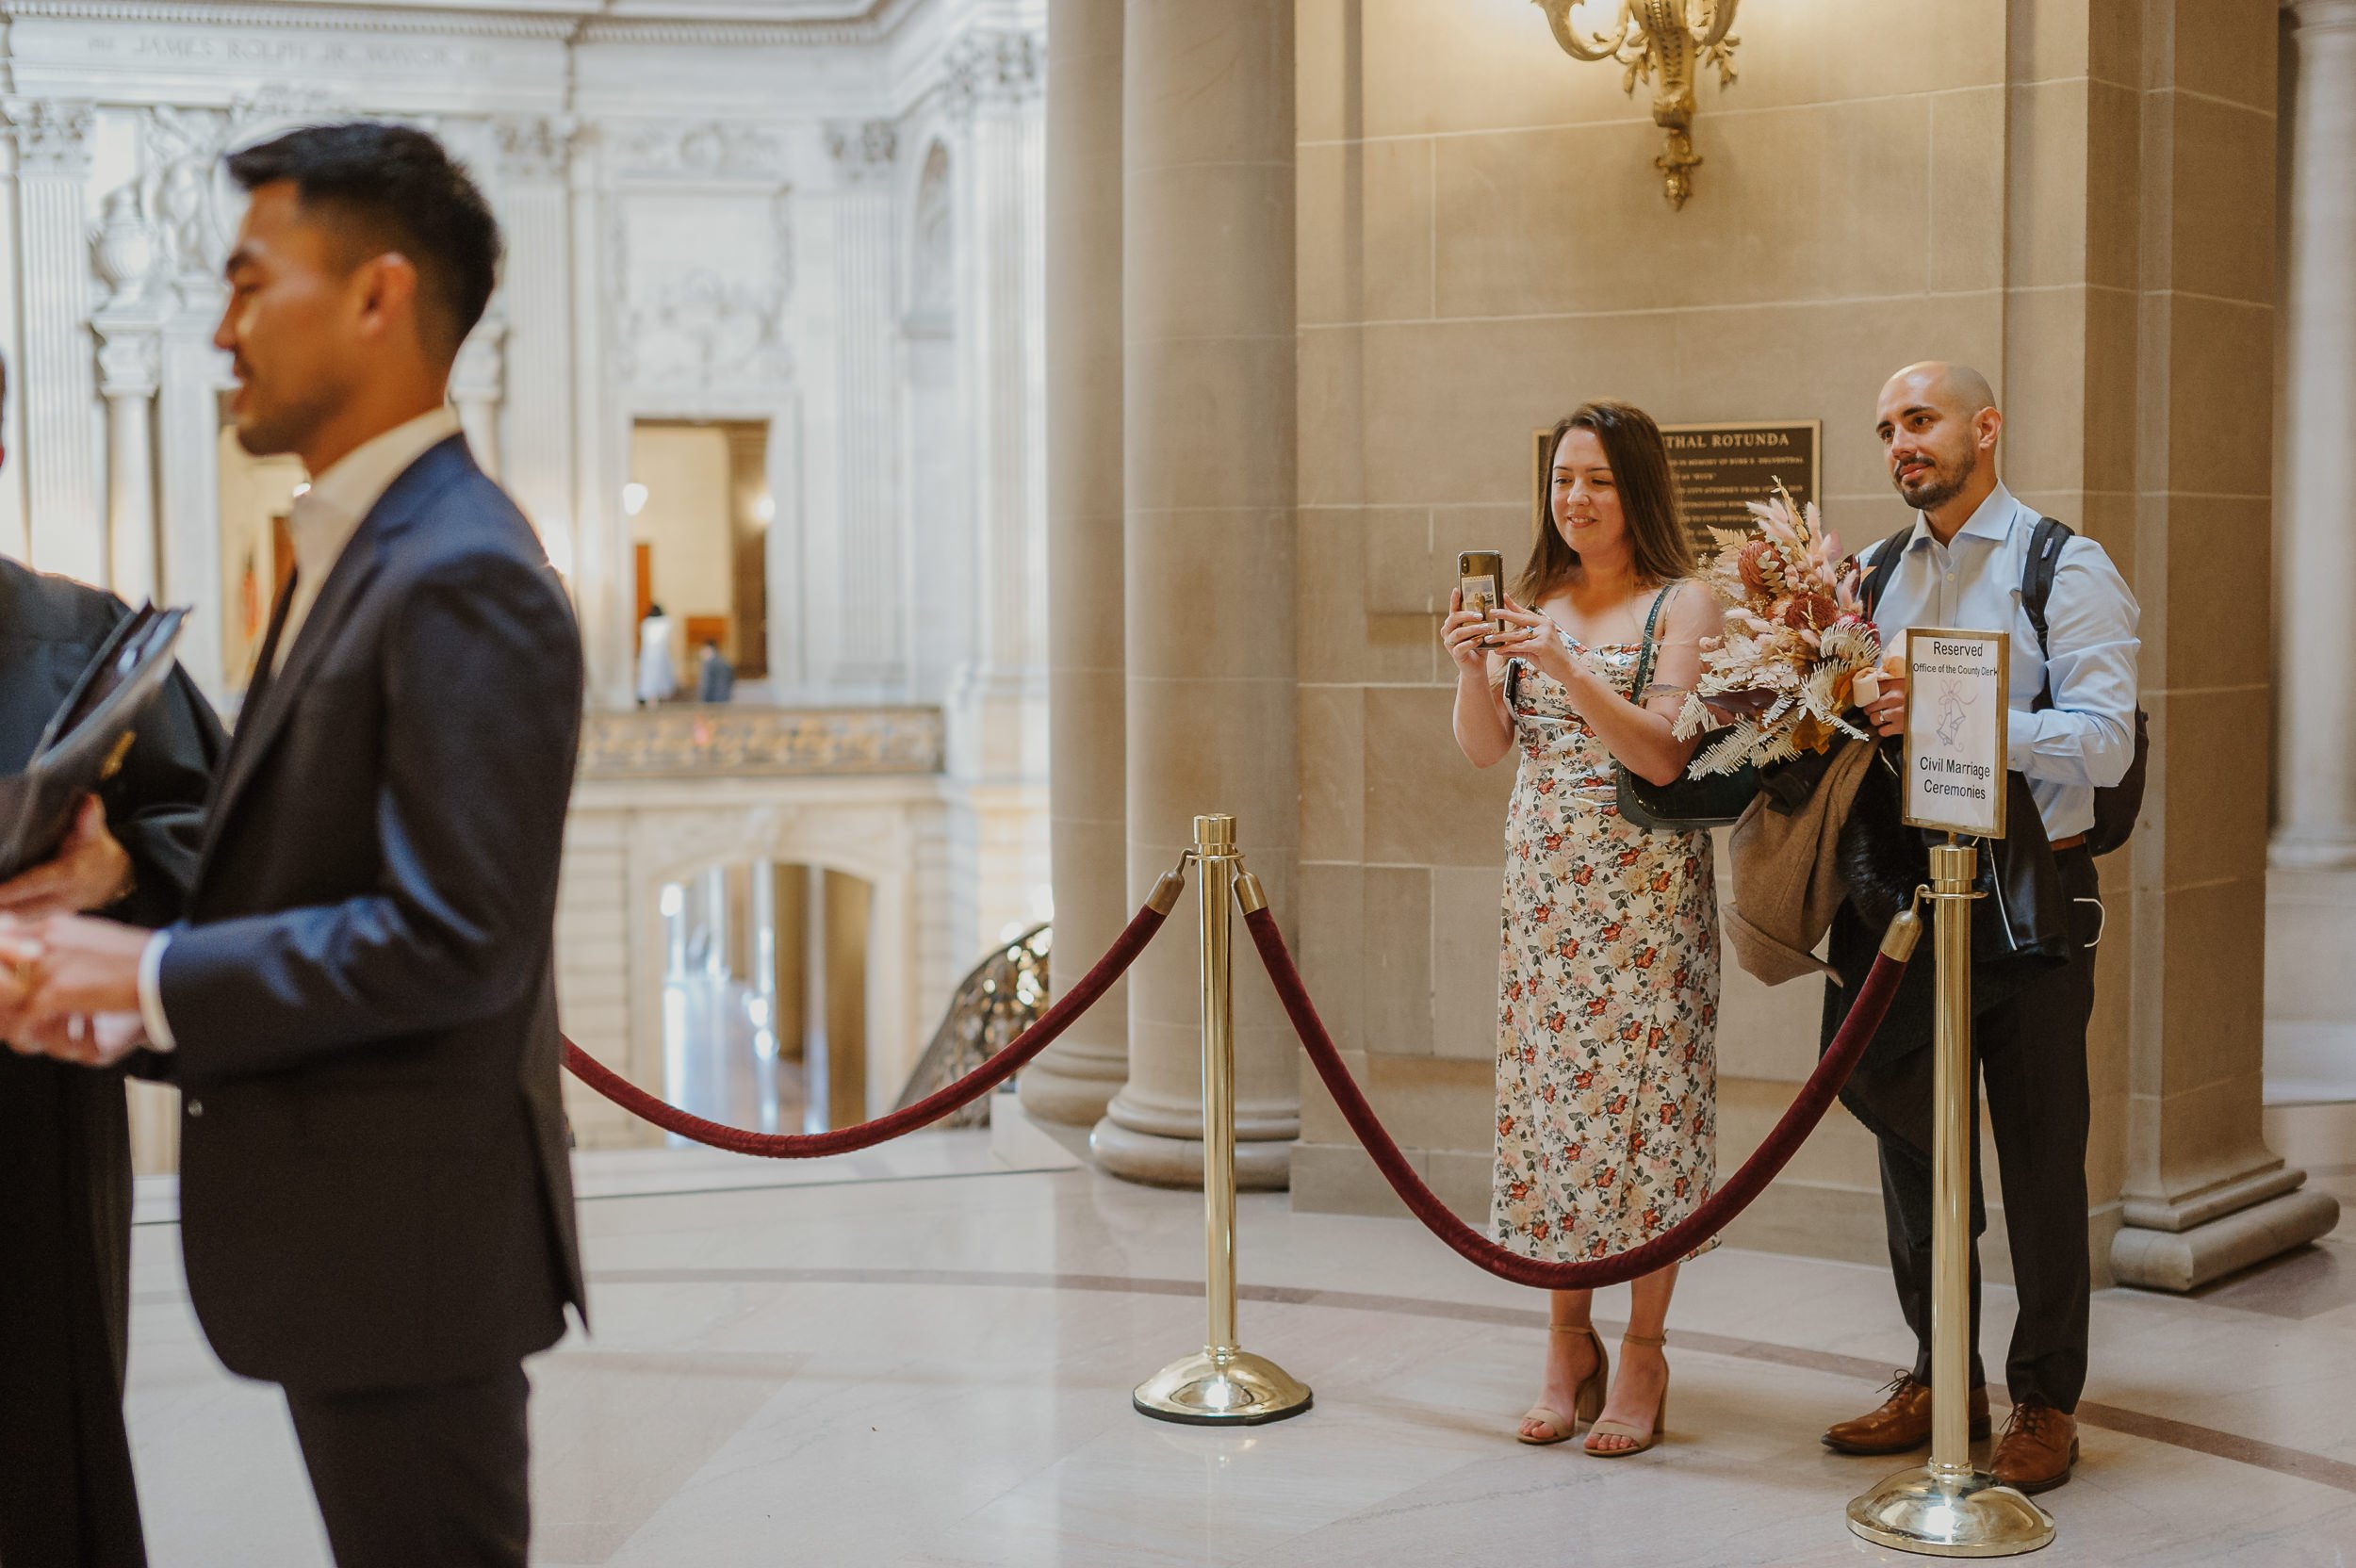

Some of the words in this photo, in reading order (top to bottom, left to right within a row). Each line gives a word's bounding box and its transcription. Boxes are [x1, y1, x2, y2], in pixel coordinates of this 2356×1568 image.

[1662, 435, 1707, 449] THAL
[1711, 433, 1790, 448] ROTUNDA
[1933, 641, 1983, 657] Reserved
[1912, 662, 1937, 673] Office
[1938, 664, 1945, 674] of
[1946, 664, 1956, 674] the
[1957, 665, 1980, 678] County
[1981, 666, 1998, 677] Clerk
[1920, 757, 1943, 772] Civil
[1946, 759, 1990, 780] Marriage
[1923, 779, 1986, 799] Ceremonies
